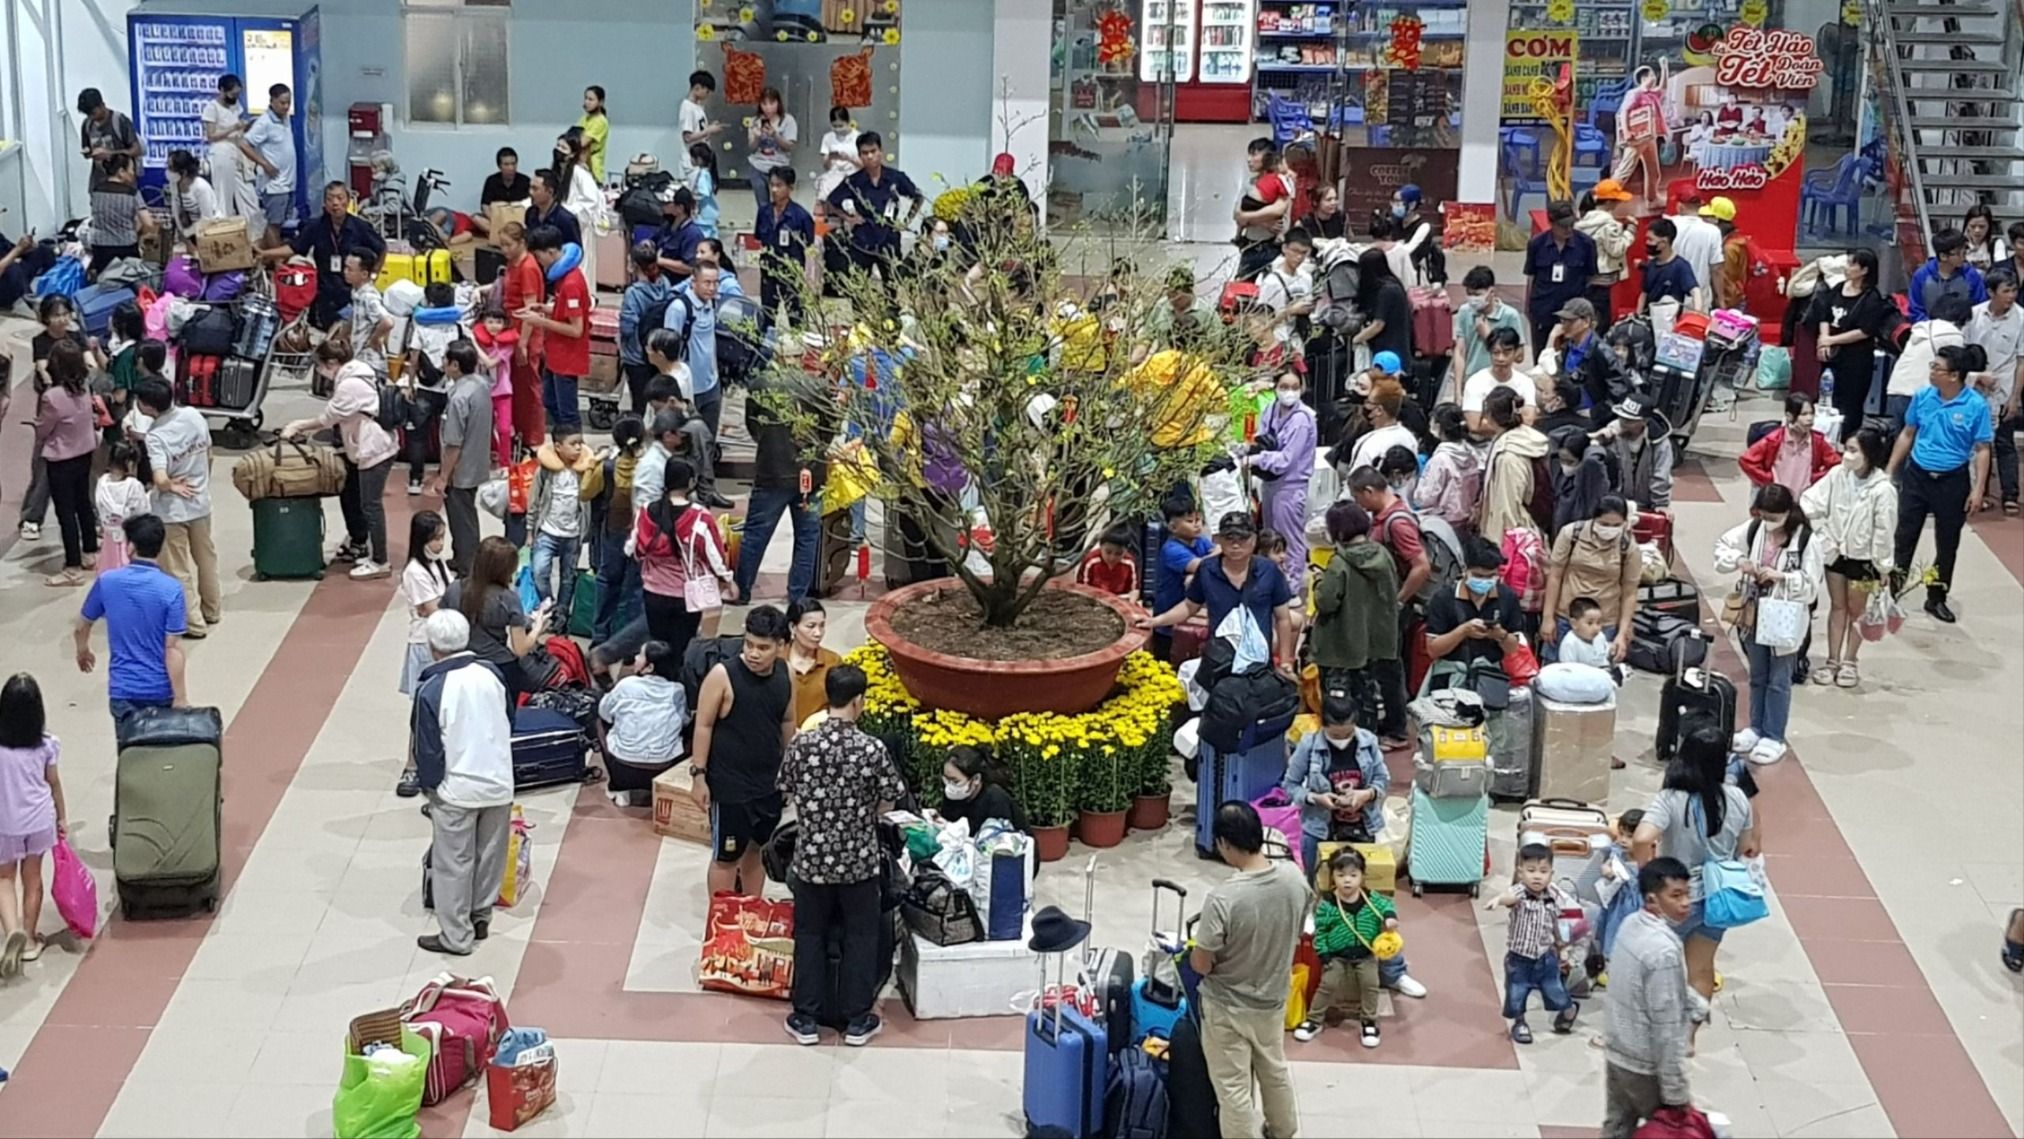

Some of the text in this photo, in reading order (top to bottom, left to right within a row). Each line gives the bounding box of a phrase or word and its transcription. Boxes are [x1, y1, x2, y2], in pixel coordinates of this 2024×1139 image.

[1507, 34, 1572, 57] CƠM
[1729, 29, 1812, 54] Tết Hảo
[1718, 54, 1772, 85] Tết
[1775, 55, 1821, 71] Đoàn
[1775, 72, 1813, 87] Viên
[1699, 168, 1763, 188] Hảo Hảo
